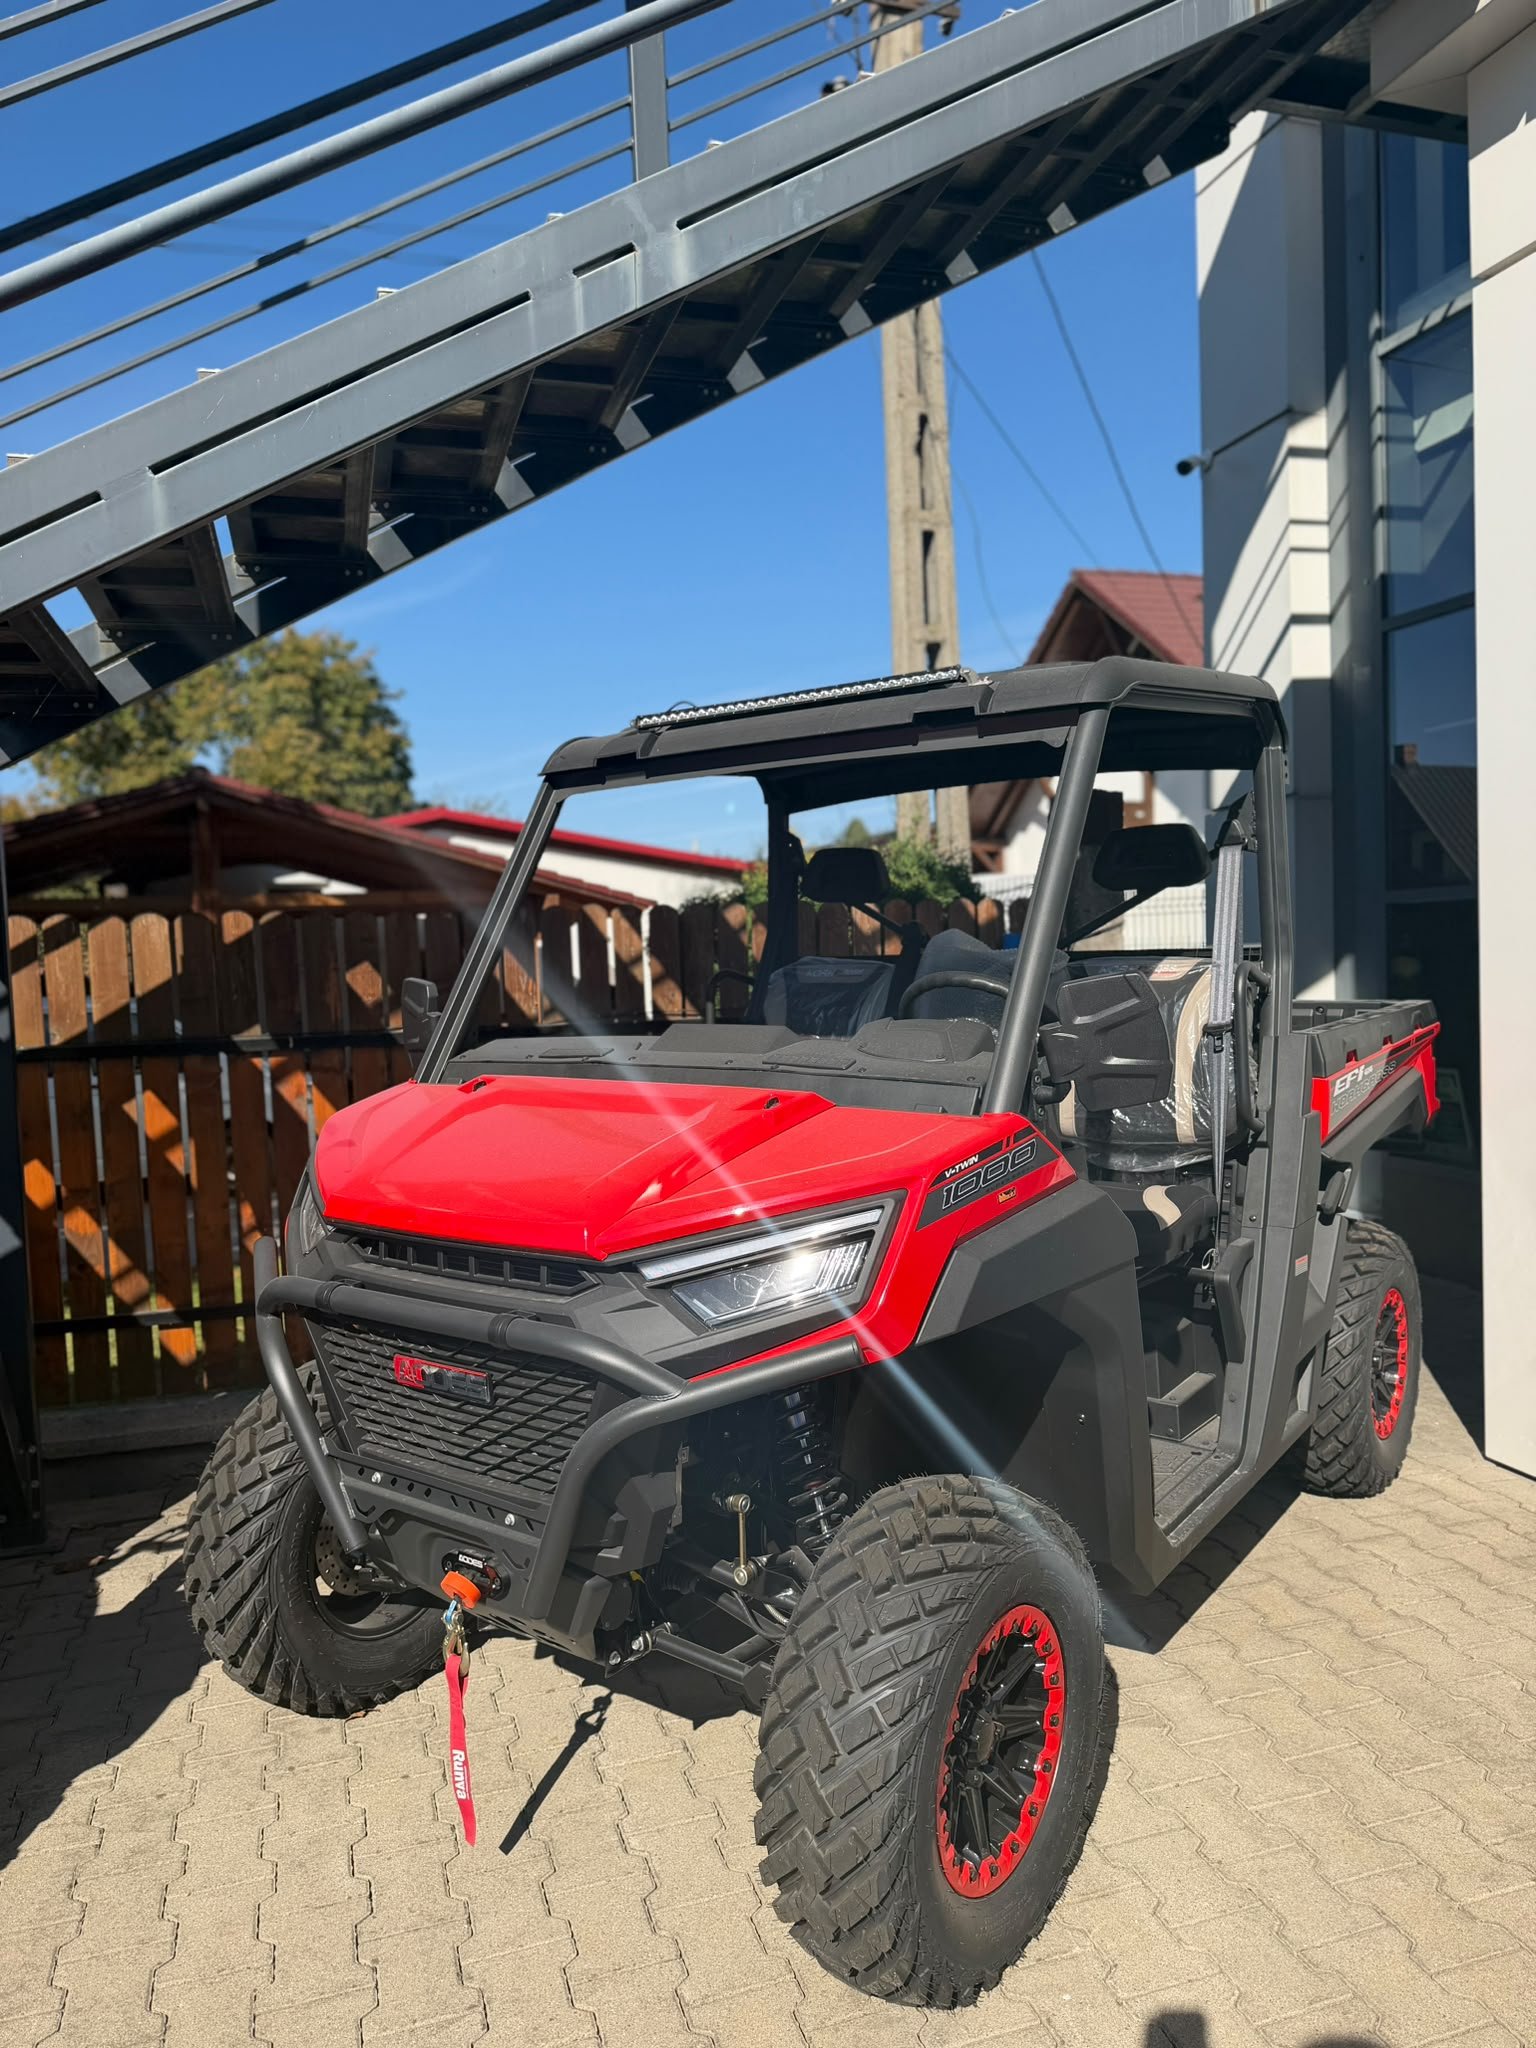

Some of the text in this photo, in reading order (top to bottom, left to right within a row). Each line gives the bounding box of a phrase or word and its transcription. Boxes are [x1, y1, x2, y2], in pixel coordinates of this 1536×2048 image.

[941, 1138, 1037, 1210] 1000
[944, 1154, 979, 1179] V-TWIN
[451, 1749, 468, 1800] Runva
